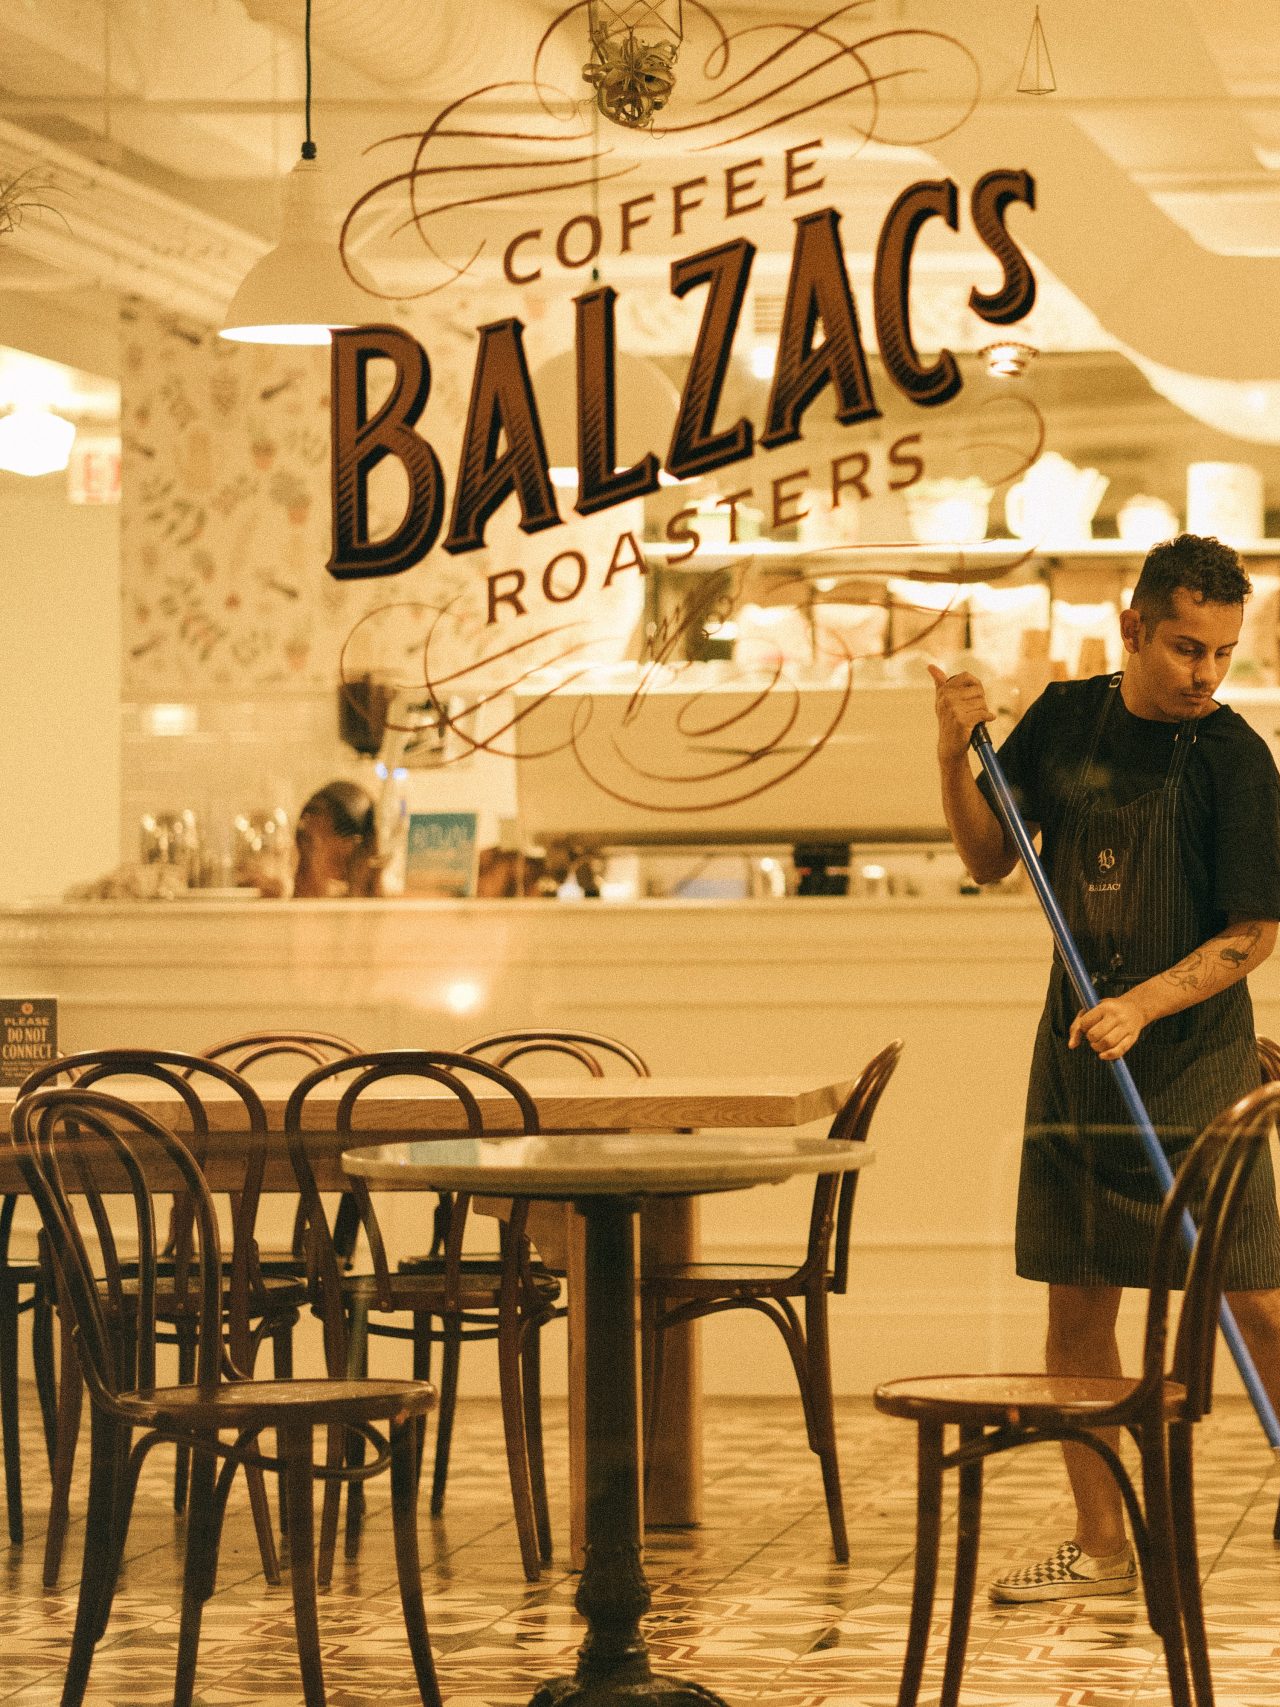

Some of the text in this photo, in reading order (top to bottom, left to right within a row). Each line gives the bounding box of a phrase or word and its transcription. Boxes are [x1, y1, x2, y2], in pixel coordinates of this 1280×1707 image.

[503, 139, 828, 286] COFFEE
[325, 168, 1037, 581] BALZACS
[486, 433, 926, 626] ROASTERS
[2, 1044, 52, 1059] CONNECT
[4, 1017, 49, 1026] PLEASE
[7, 1027, 47, 1043] DO NOT
